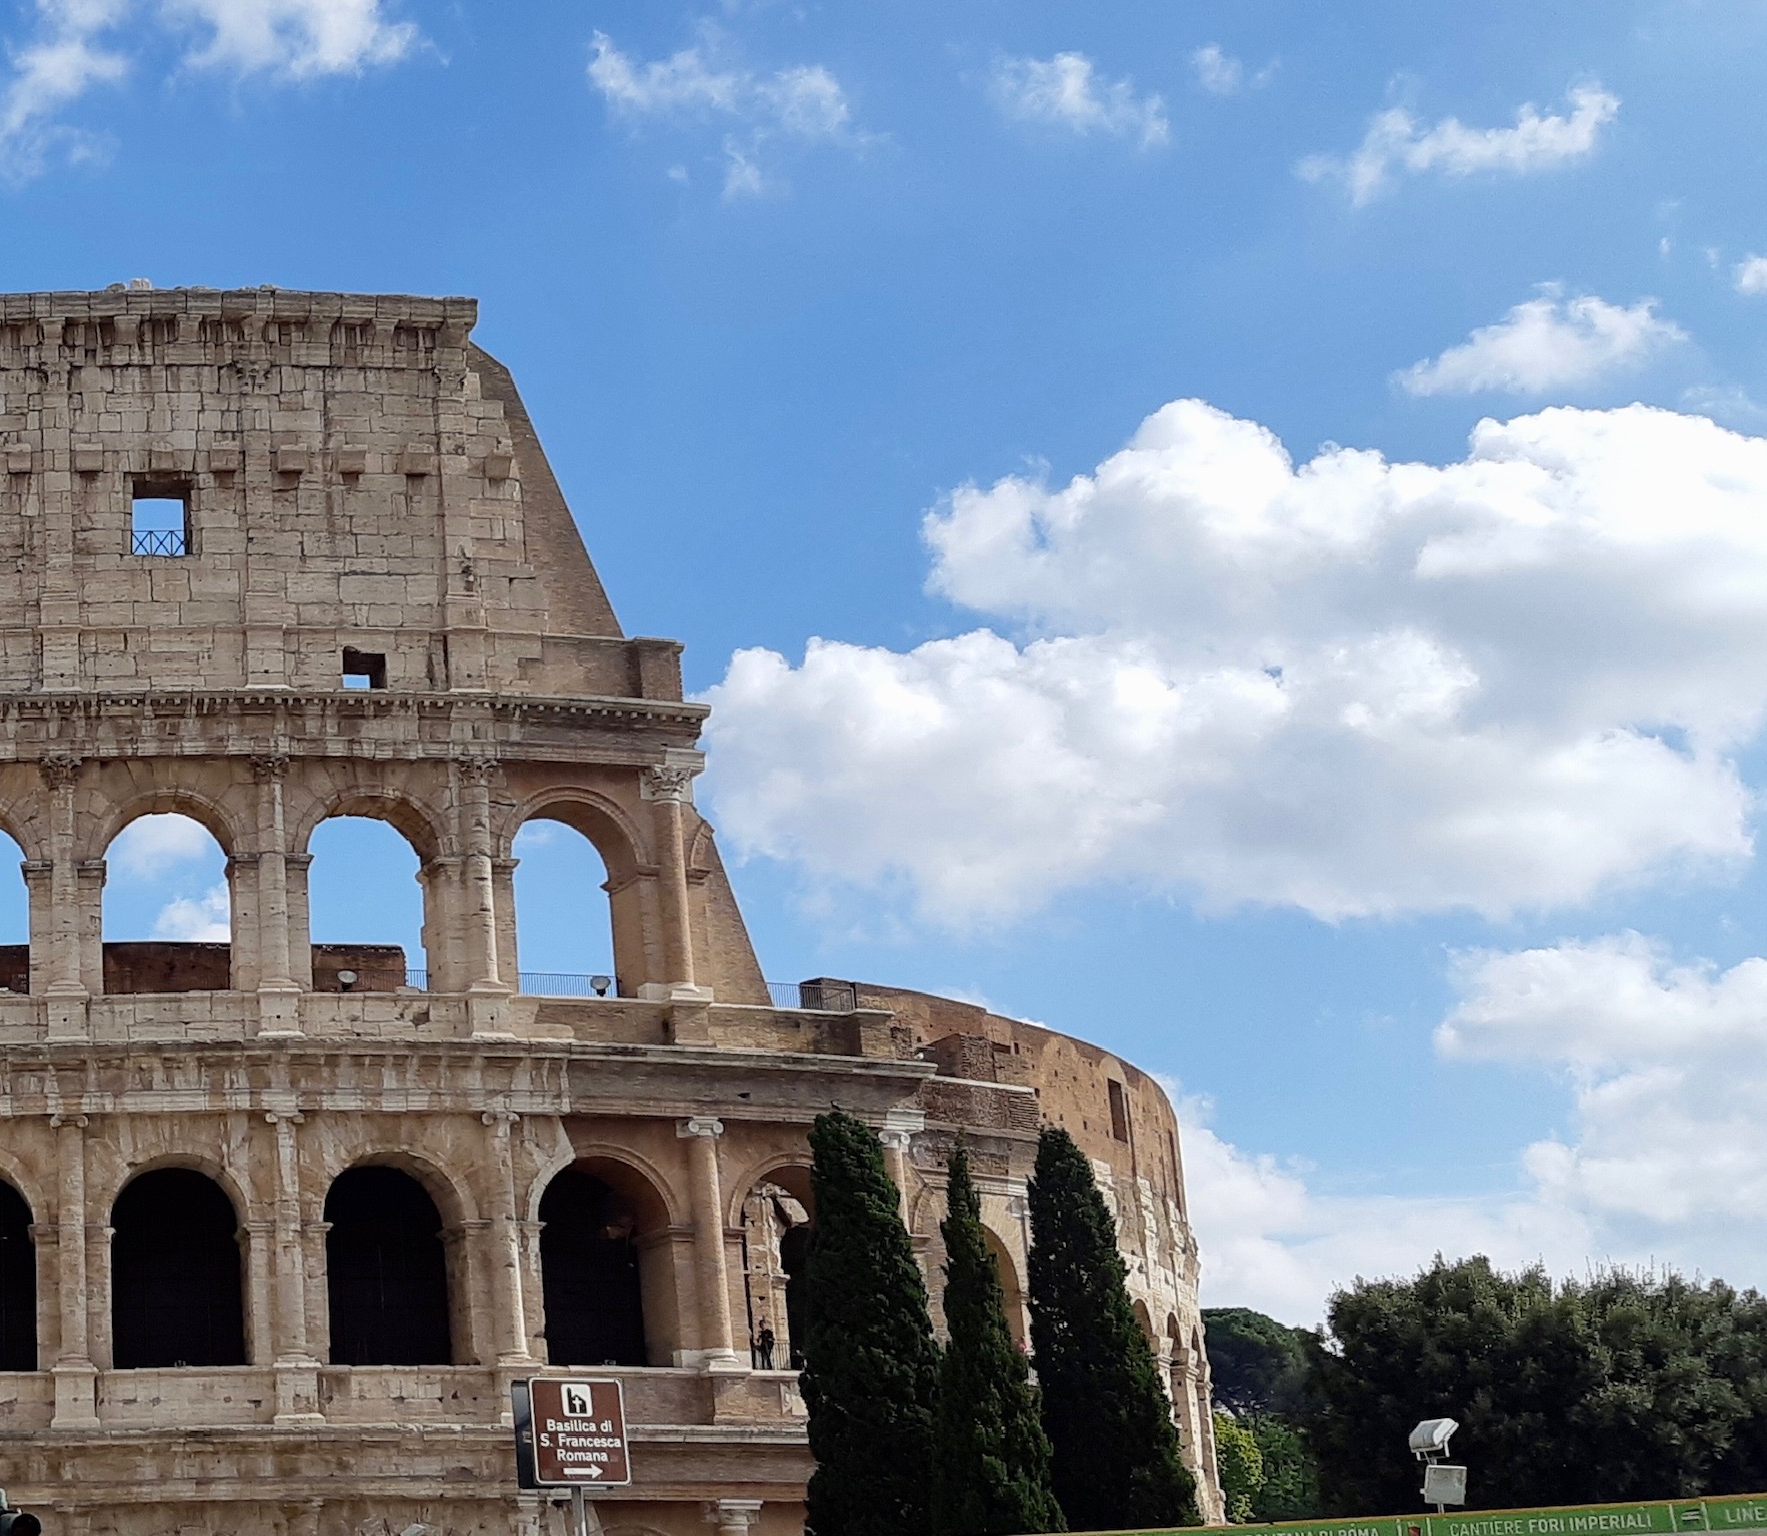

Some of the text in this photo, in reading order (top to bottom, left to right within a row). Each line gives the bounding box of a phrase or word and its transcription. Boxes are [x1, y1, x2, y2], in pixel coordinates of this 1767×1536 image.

[546, 1418, 613, 1433] Basilica di
[539, 1432, 622, 1448] S. Francesca
[556, 1448, 609, 1462] Romana
[1449, 1513, 1652, 1536] CANTIERE FORI IMPERIALI
